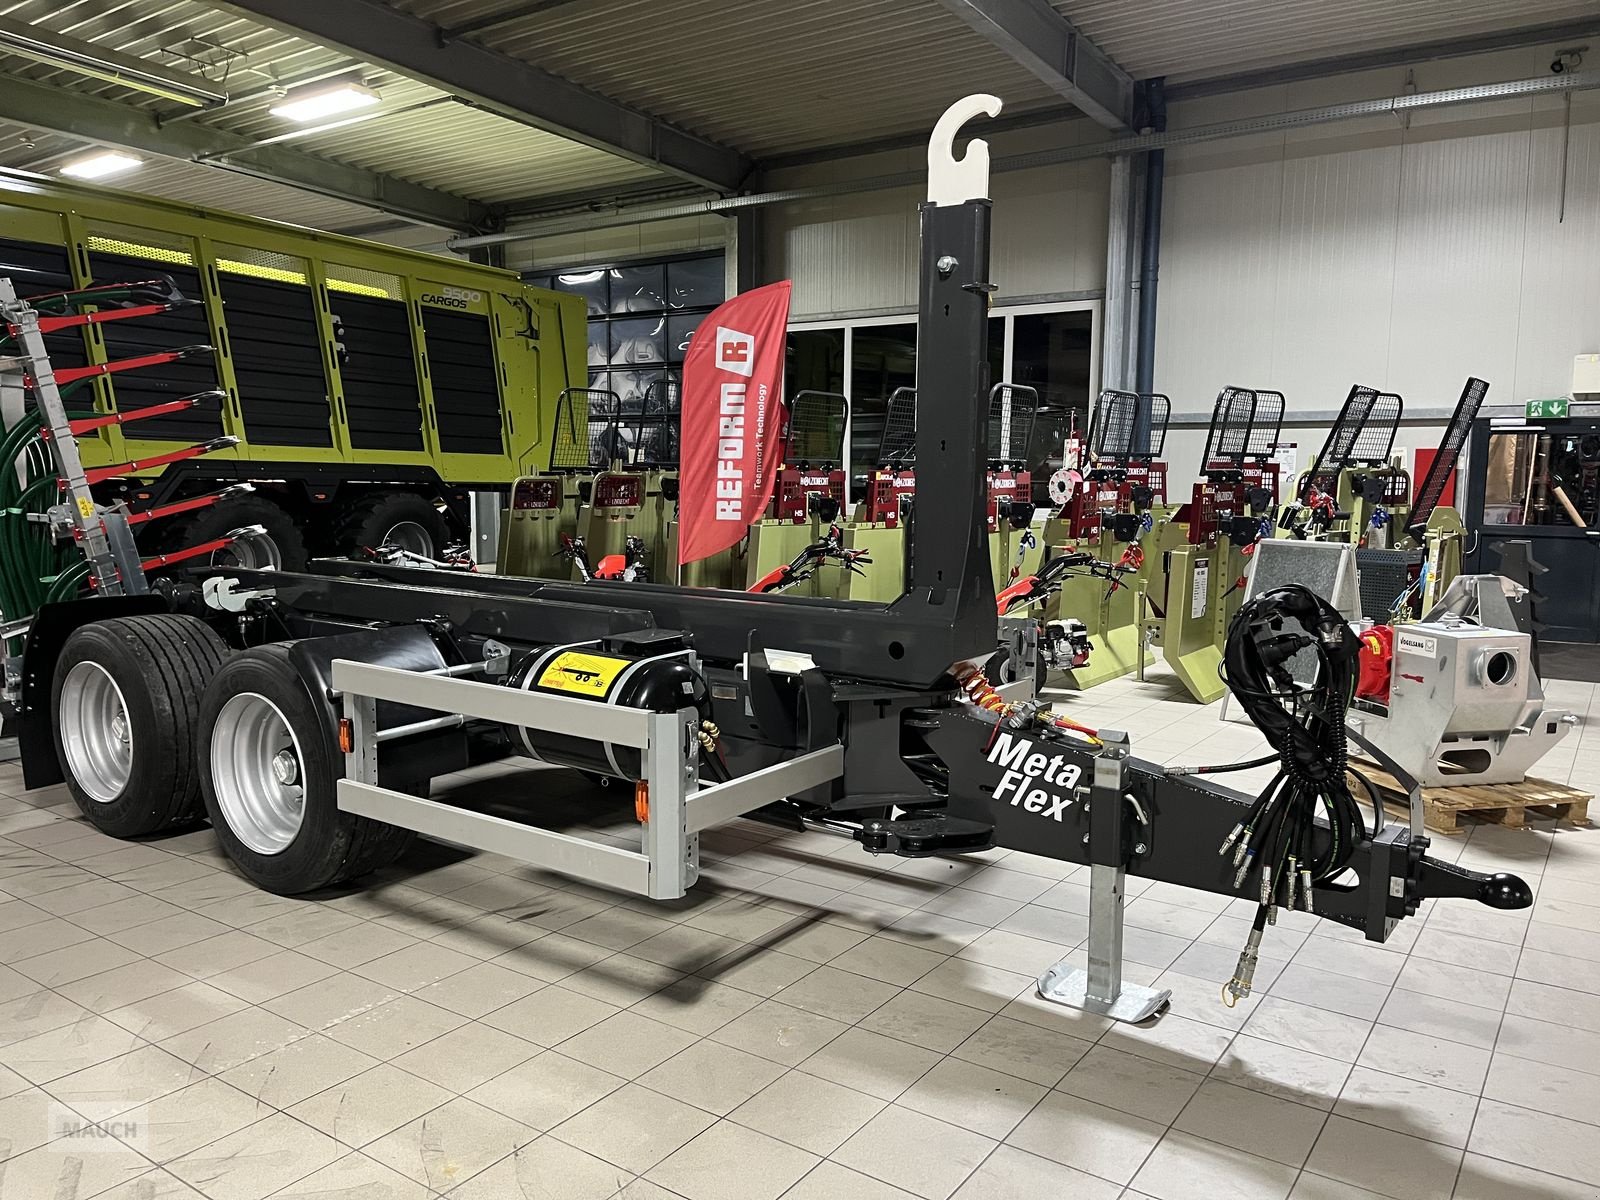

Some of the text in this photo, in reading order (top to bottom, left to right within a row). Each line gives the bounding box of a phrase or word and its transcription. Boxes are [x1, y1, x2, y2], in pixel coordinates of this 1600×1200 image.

[421, 294, 467, 309] CARGOS
[442, 287, 481, 303] 9500
[716, 383, 746, 520] REFORM
[754, 383, 767, 490] Teamwork Technology
[1400, 636, 1424, 649] VOGELSANG
[986, 732, 1082, 790] Meta
[991, 770, 1073, 823] Flex
